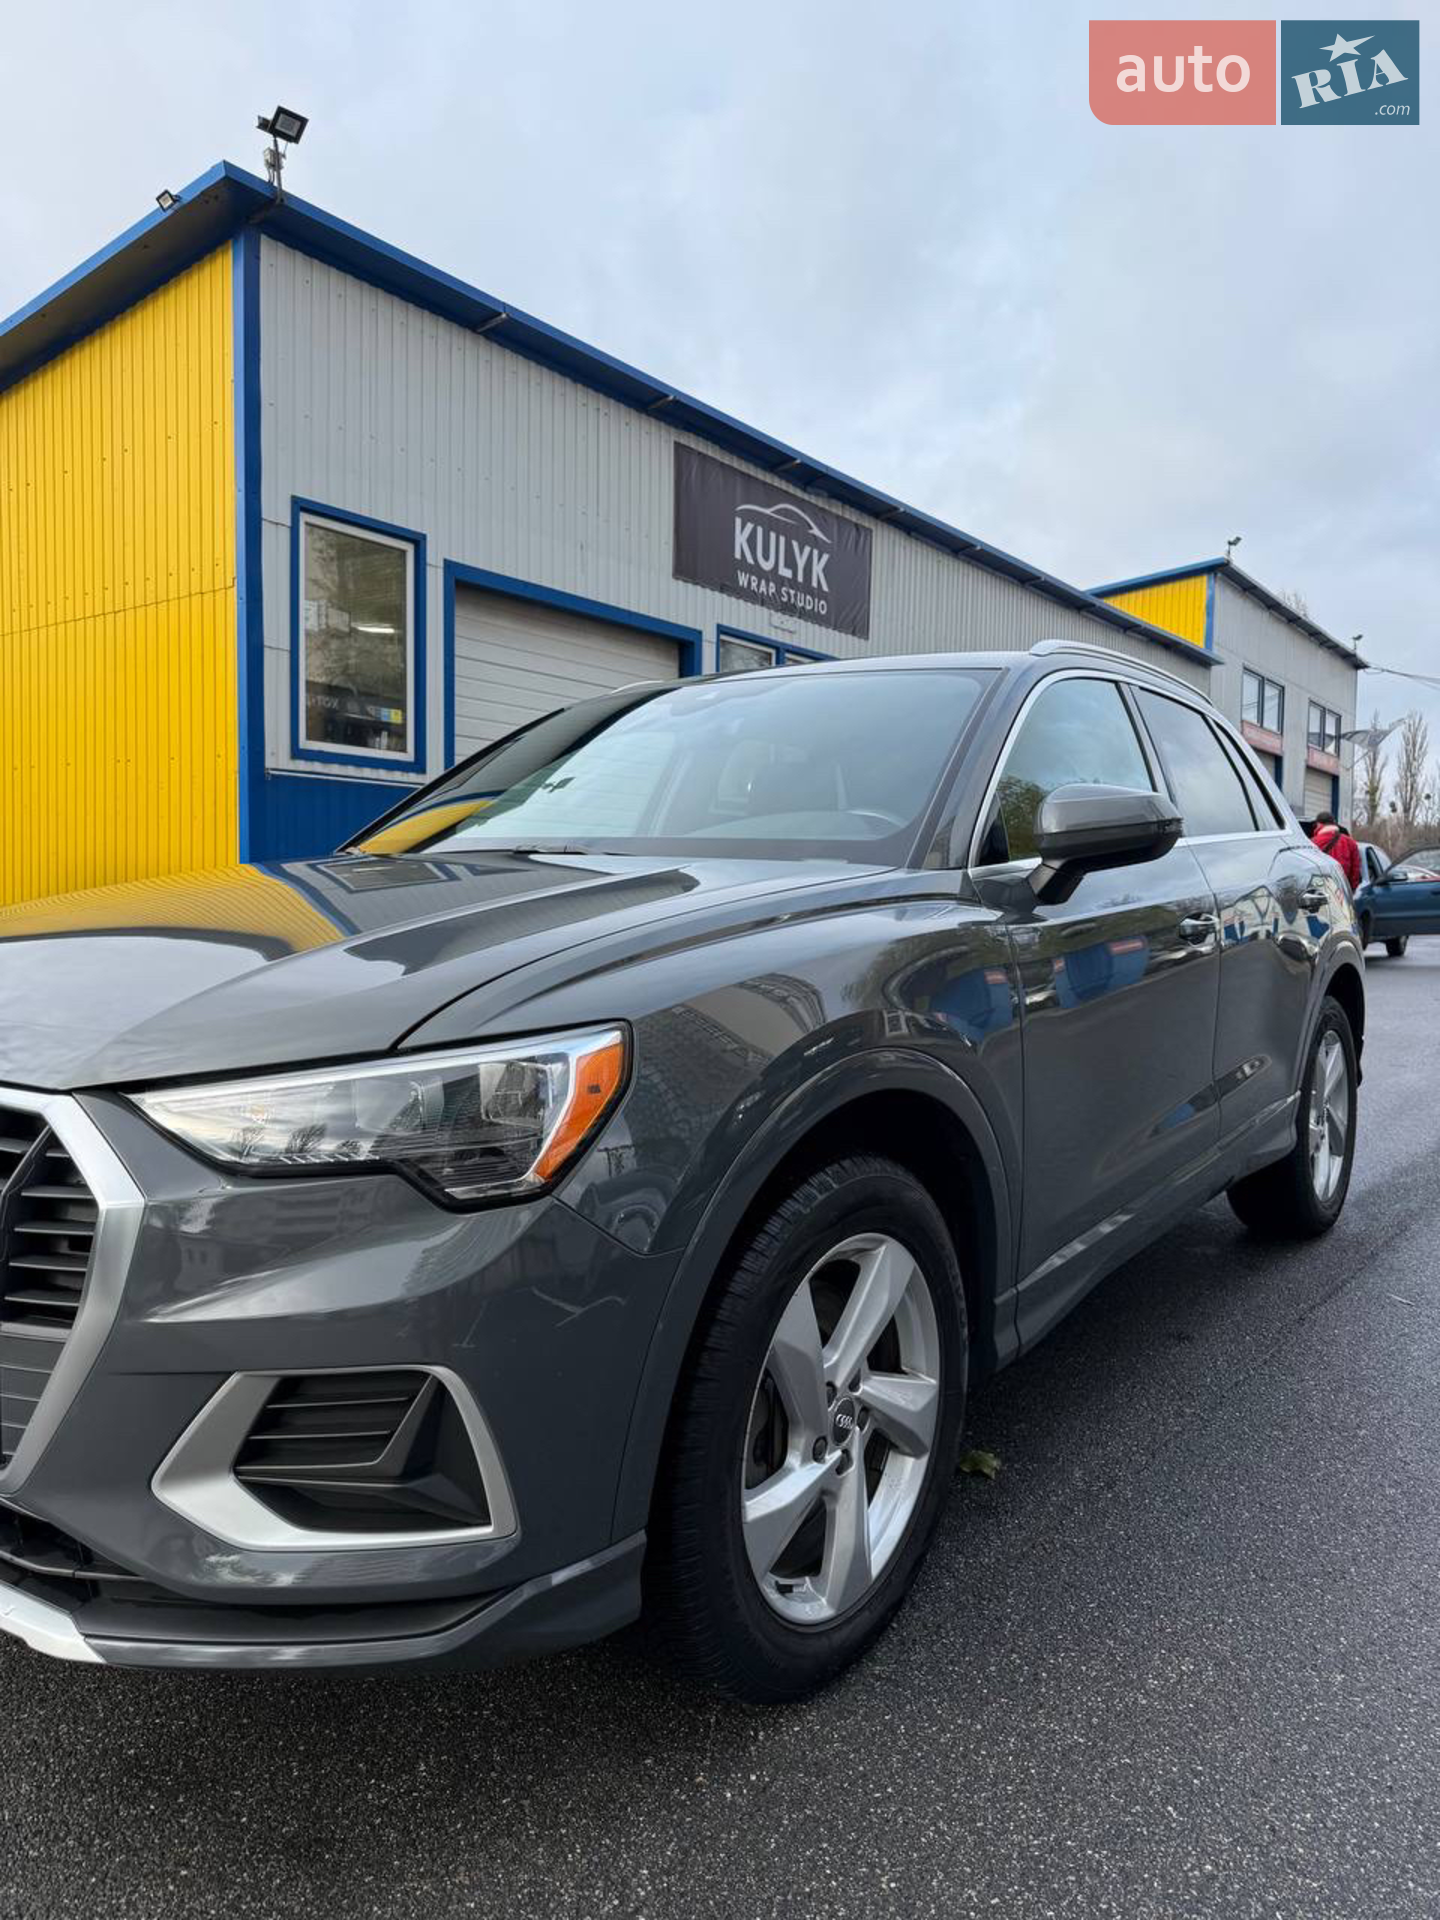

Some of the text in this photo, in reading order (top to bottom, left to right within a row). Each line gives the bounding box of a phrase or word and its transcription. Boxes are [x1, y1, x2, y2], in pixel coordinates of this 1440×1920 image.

[734, 516, 830, 592] KULYK
[737, 570, 828, 615] WRAP STUDIO
